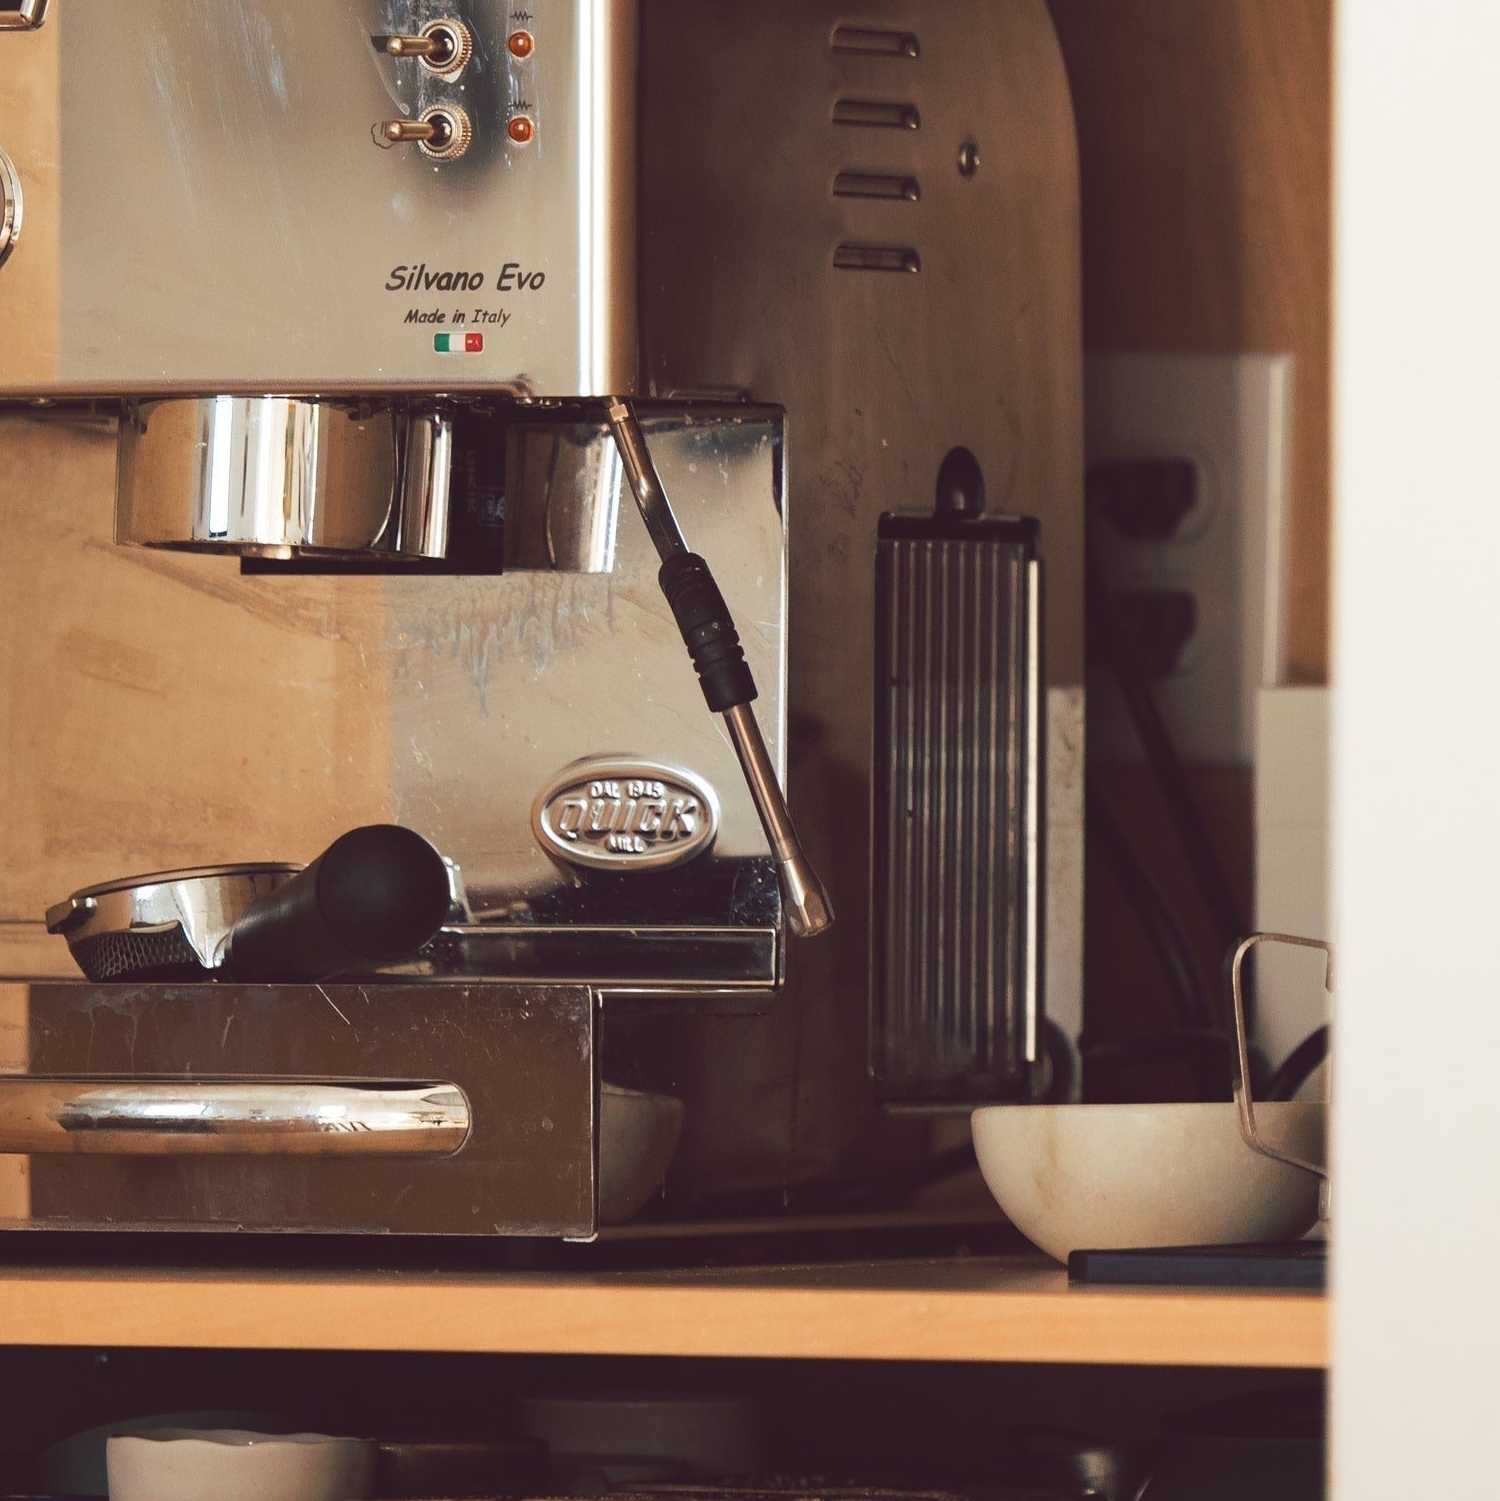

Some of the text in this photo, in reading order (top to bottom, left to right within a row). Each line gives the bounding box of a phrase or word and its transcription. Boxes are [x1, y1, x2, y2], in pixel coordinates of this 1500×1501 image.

[385, 263, 546, 291] Silvano Evo
[403, 308, 511, 328] Made in Italy
[559, 798, 698, 839] QUICK
